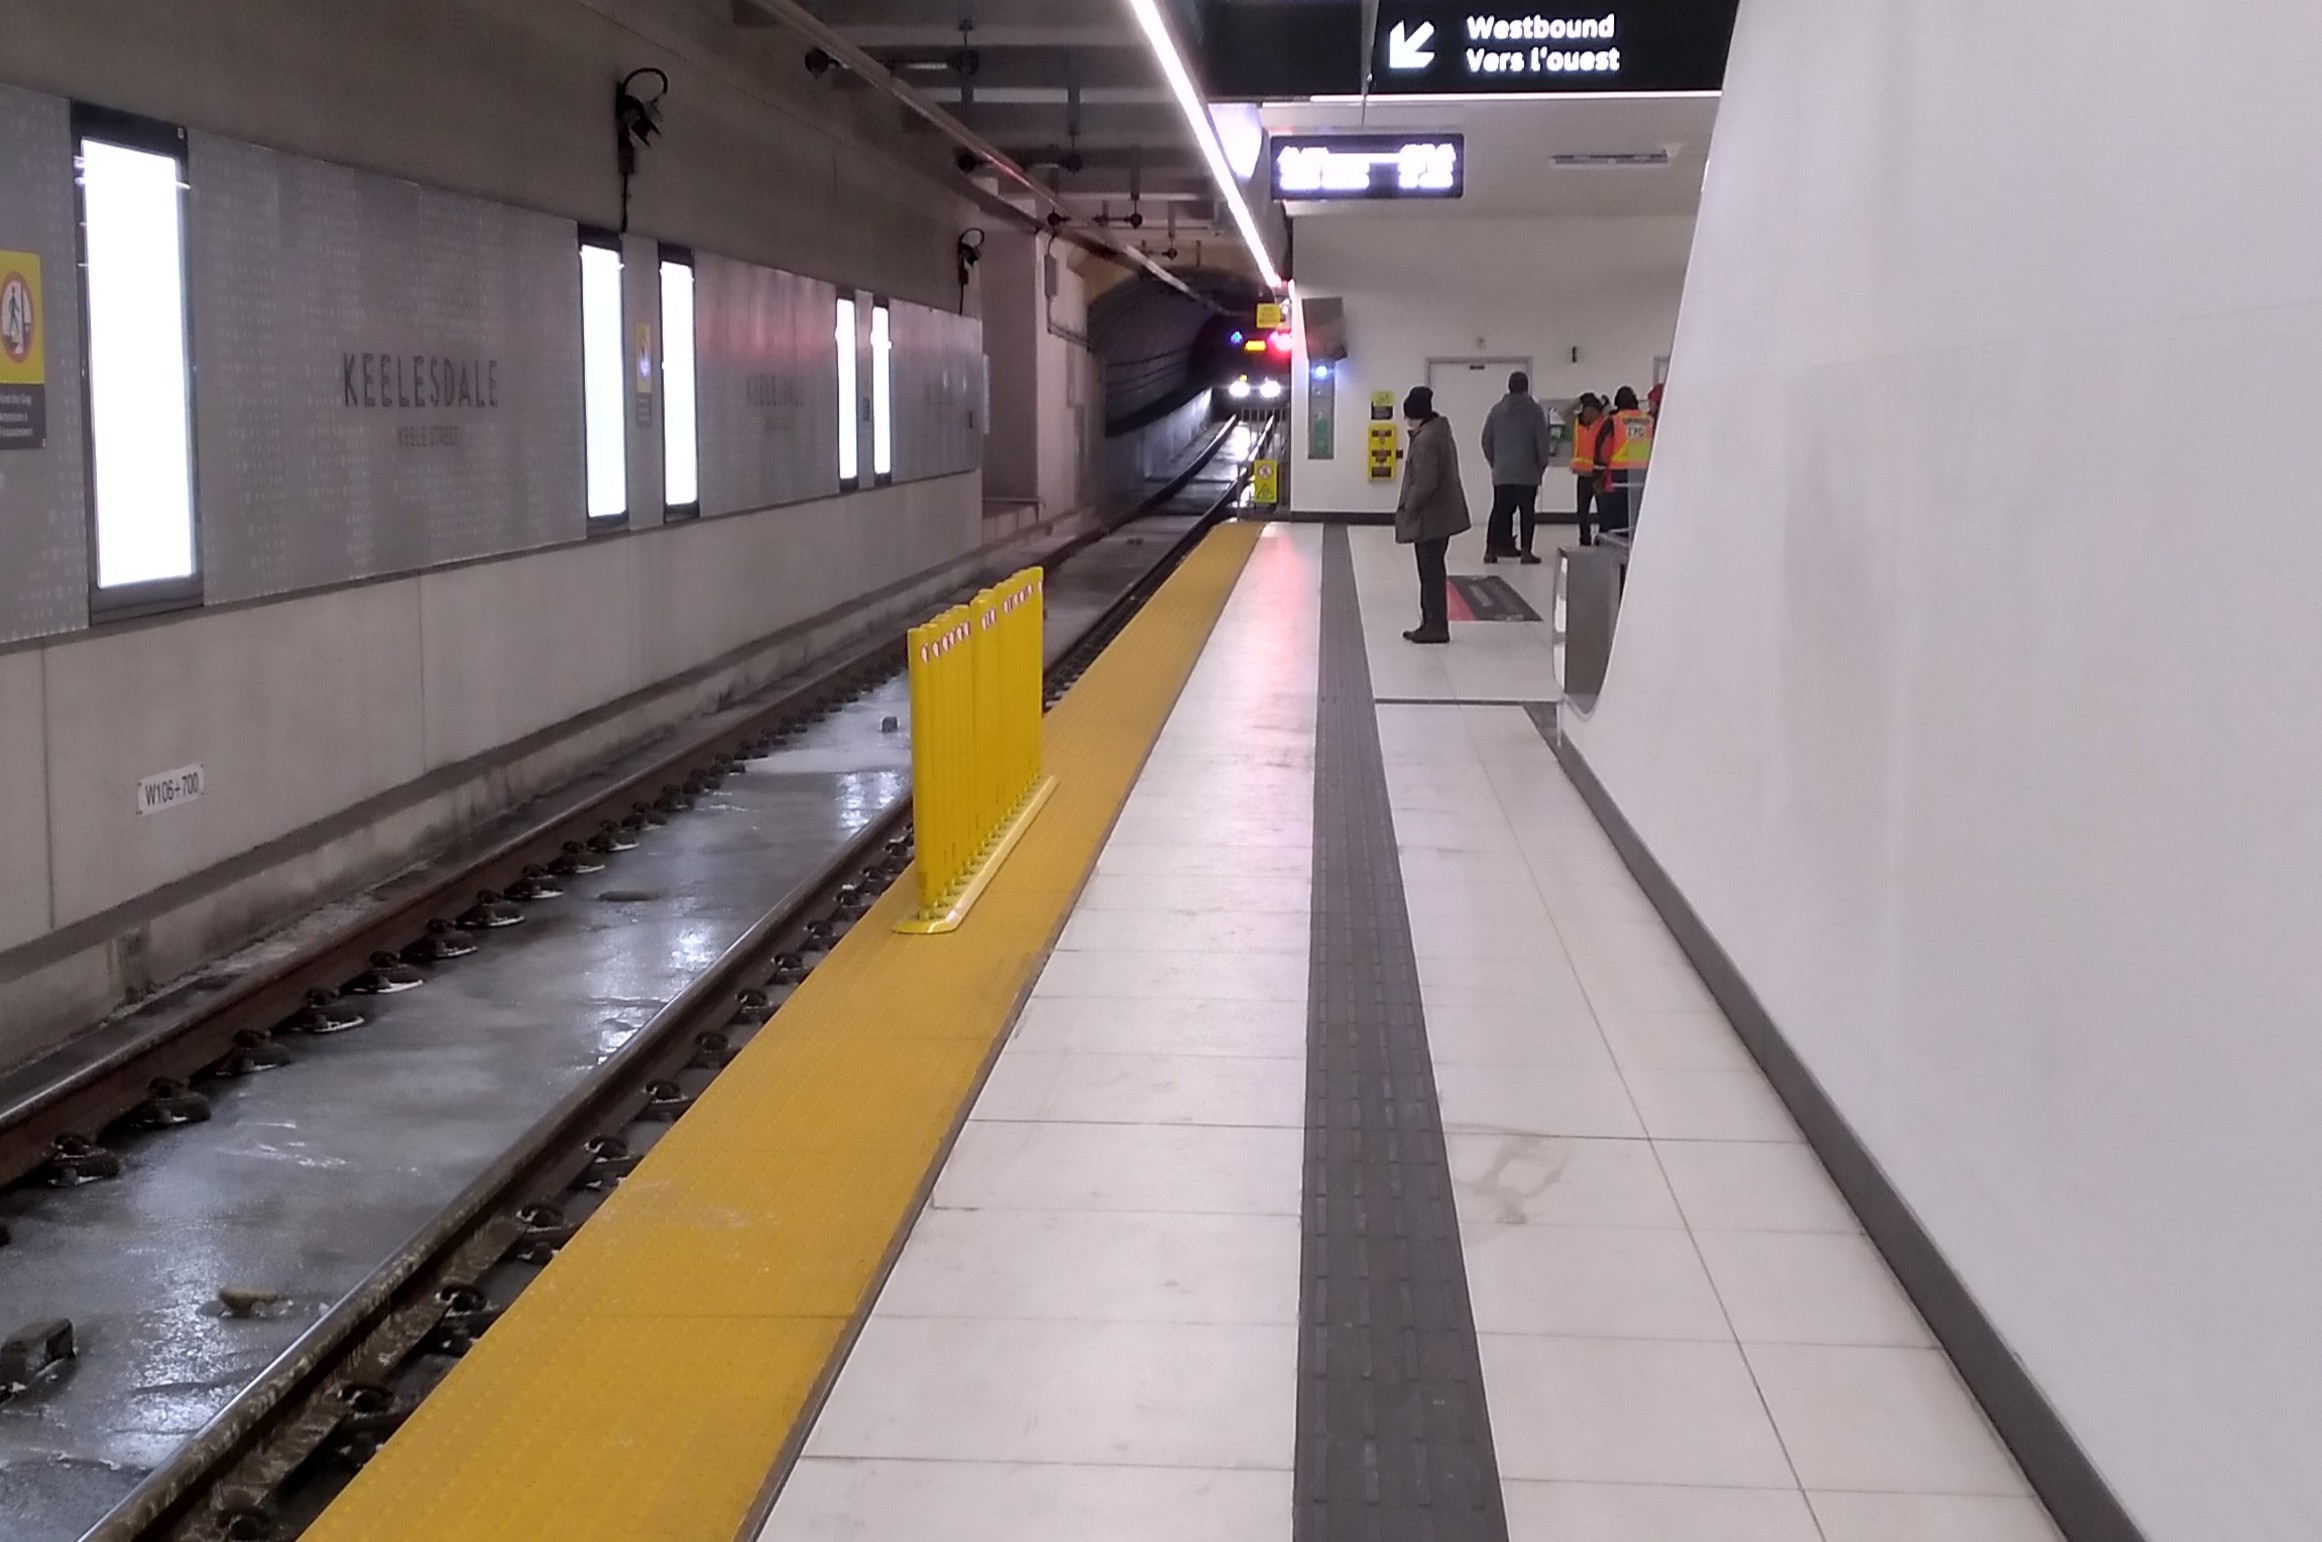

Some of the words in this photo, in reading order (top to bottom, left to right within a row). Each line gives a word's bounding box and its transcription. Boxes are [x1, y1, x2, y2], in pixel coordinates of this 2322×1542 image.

[1467, 13, 1615, 40] Westbound
[1466, 48, 1525, 72] Vers
[1531, 46, 1620, 72] l'ouest
[344, 352, 499, 408] KEELESDALE
